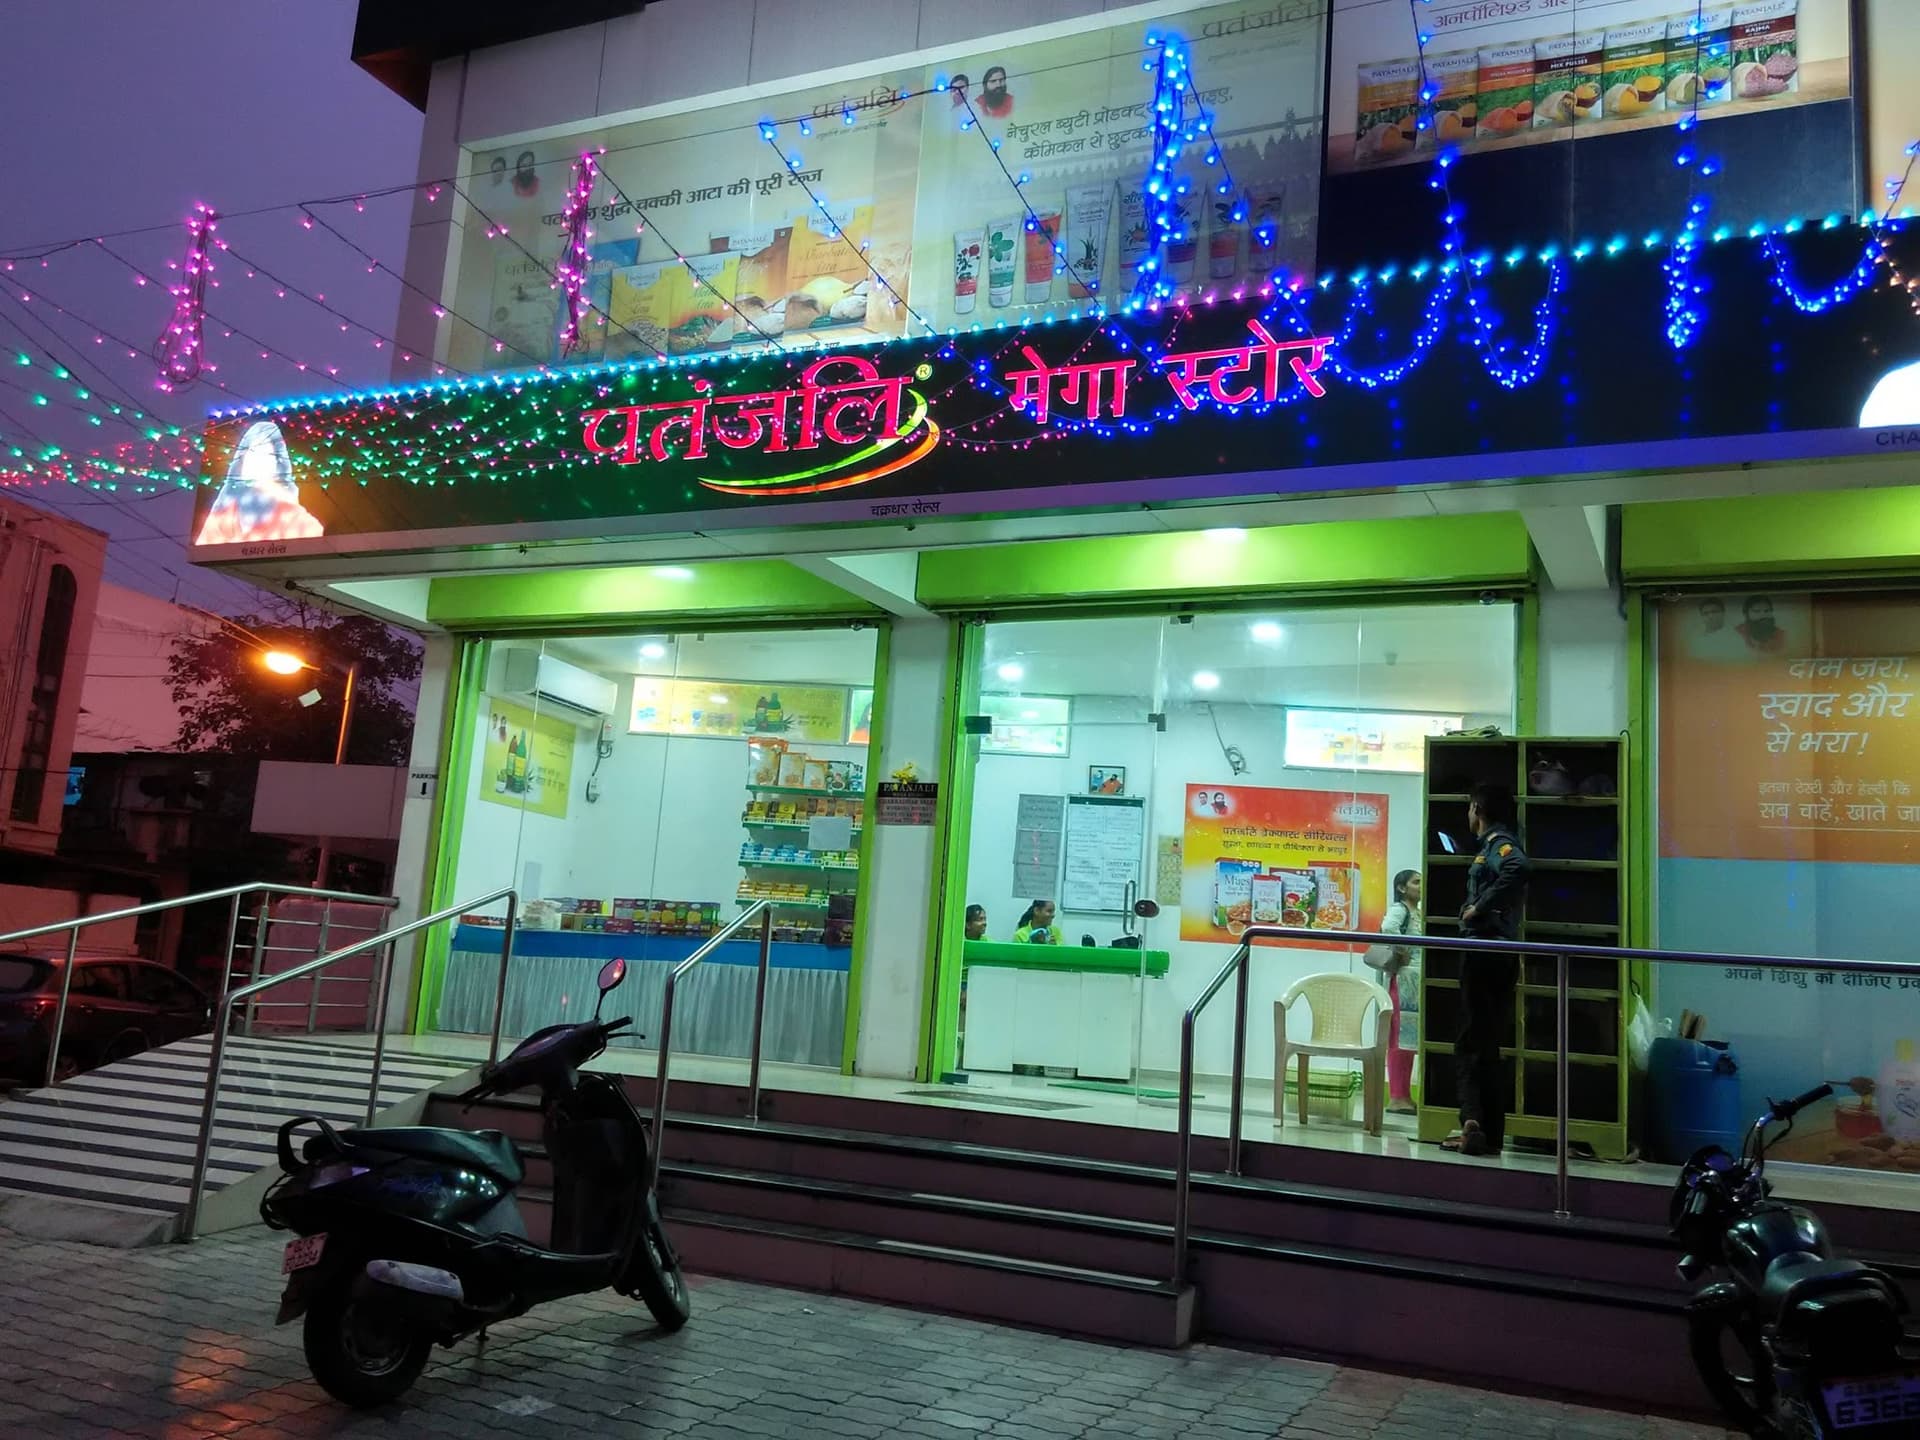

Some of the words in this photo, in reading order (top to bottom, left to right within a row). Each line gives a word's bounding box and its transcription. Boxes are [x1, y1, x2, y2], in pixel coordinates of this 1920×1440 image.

[1023, 135, 1084, 161] केमिकल
[686, 185, 722, 204] आटा
[726, 177, 751, 197] की
[755, 172, 783, 197] पूरी
[581, 356, 914, 464] पतंजलि
[1005, 346, 1136, 424] मेगा
[1162, 319, 1334, 410] स्टोर
[911, 499, 942, 514] सेल्स
[1788, 657, 1847, 678] दाम
[1758, 693, 1840, 720] स्वाद
[1842, 683, 1914, 718] और
[1766, 723, 1795, 753] से
[1829, 776, 1853, 795] और
[1758, 802, 1790, 818] सब
[1846, 798, 1888, 821] खाते
